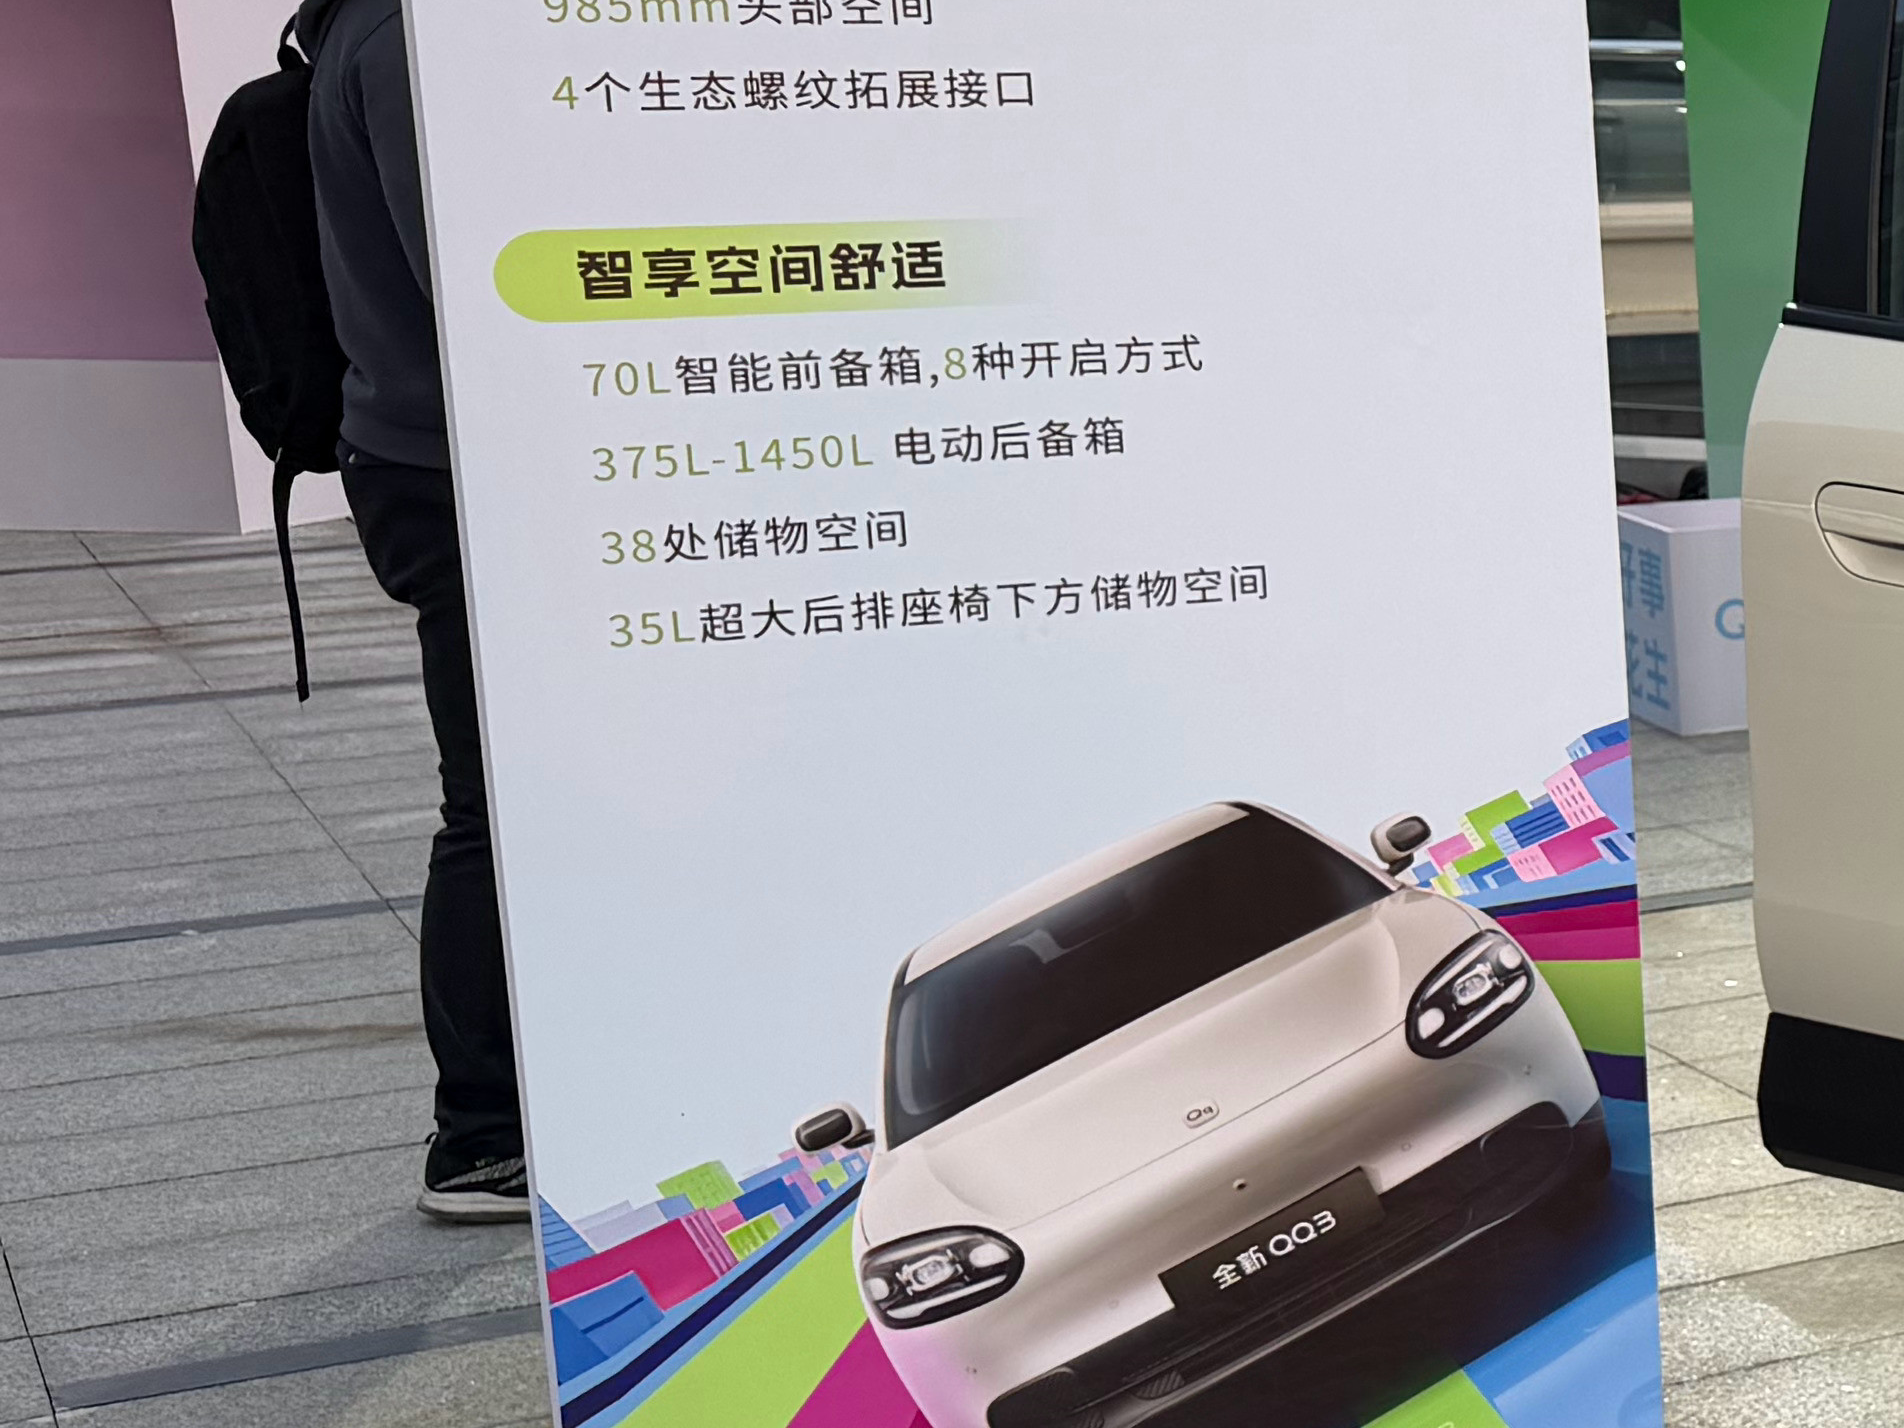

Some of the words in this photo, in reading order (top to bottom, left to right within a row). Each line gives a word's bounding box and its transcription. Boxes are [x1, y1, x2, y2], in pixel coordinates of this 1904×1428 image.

[551, 67, 1035, 113] 4个生态螺纹拓展接口
[577, 240, 947, 301] 智享空间舒适
[894, 415, 1126, 466] 电动后备箱
[601, 510, 909, 565] 38处储物空间
[609, 565, 1269, 648] 35L超大后排座椅下方储物空间
[1212, 1245, 1267, 1290] 全新
[1269, 1209, 1337, 1257] QQ3
